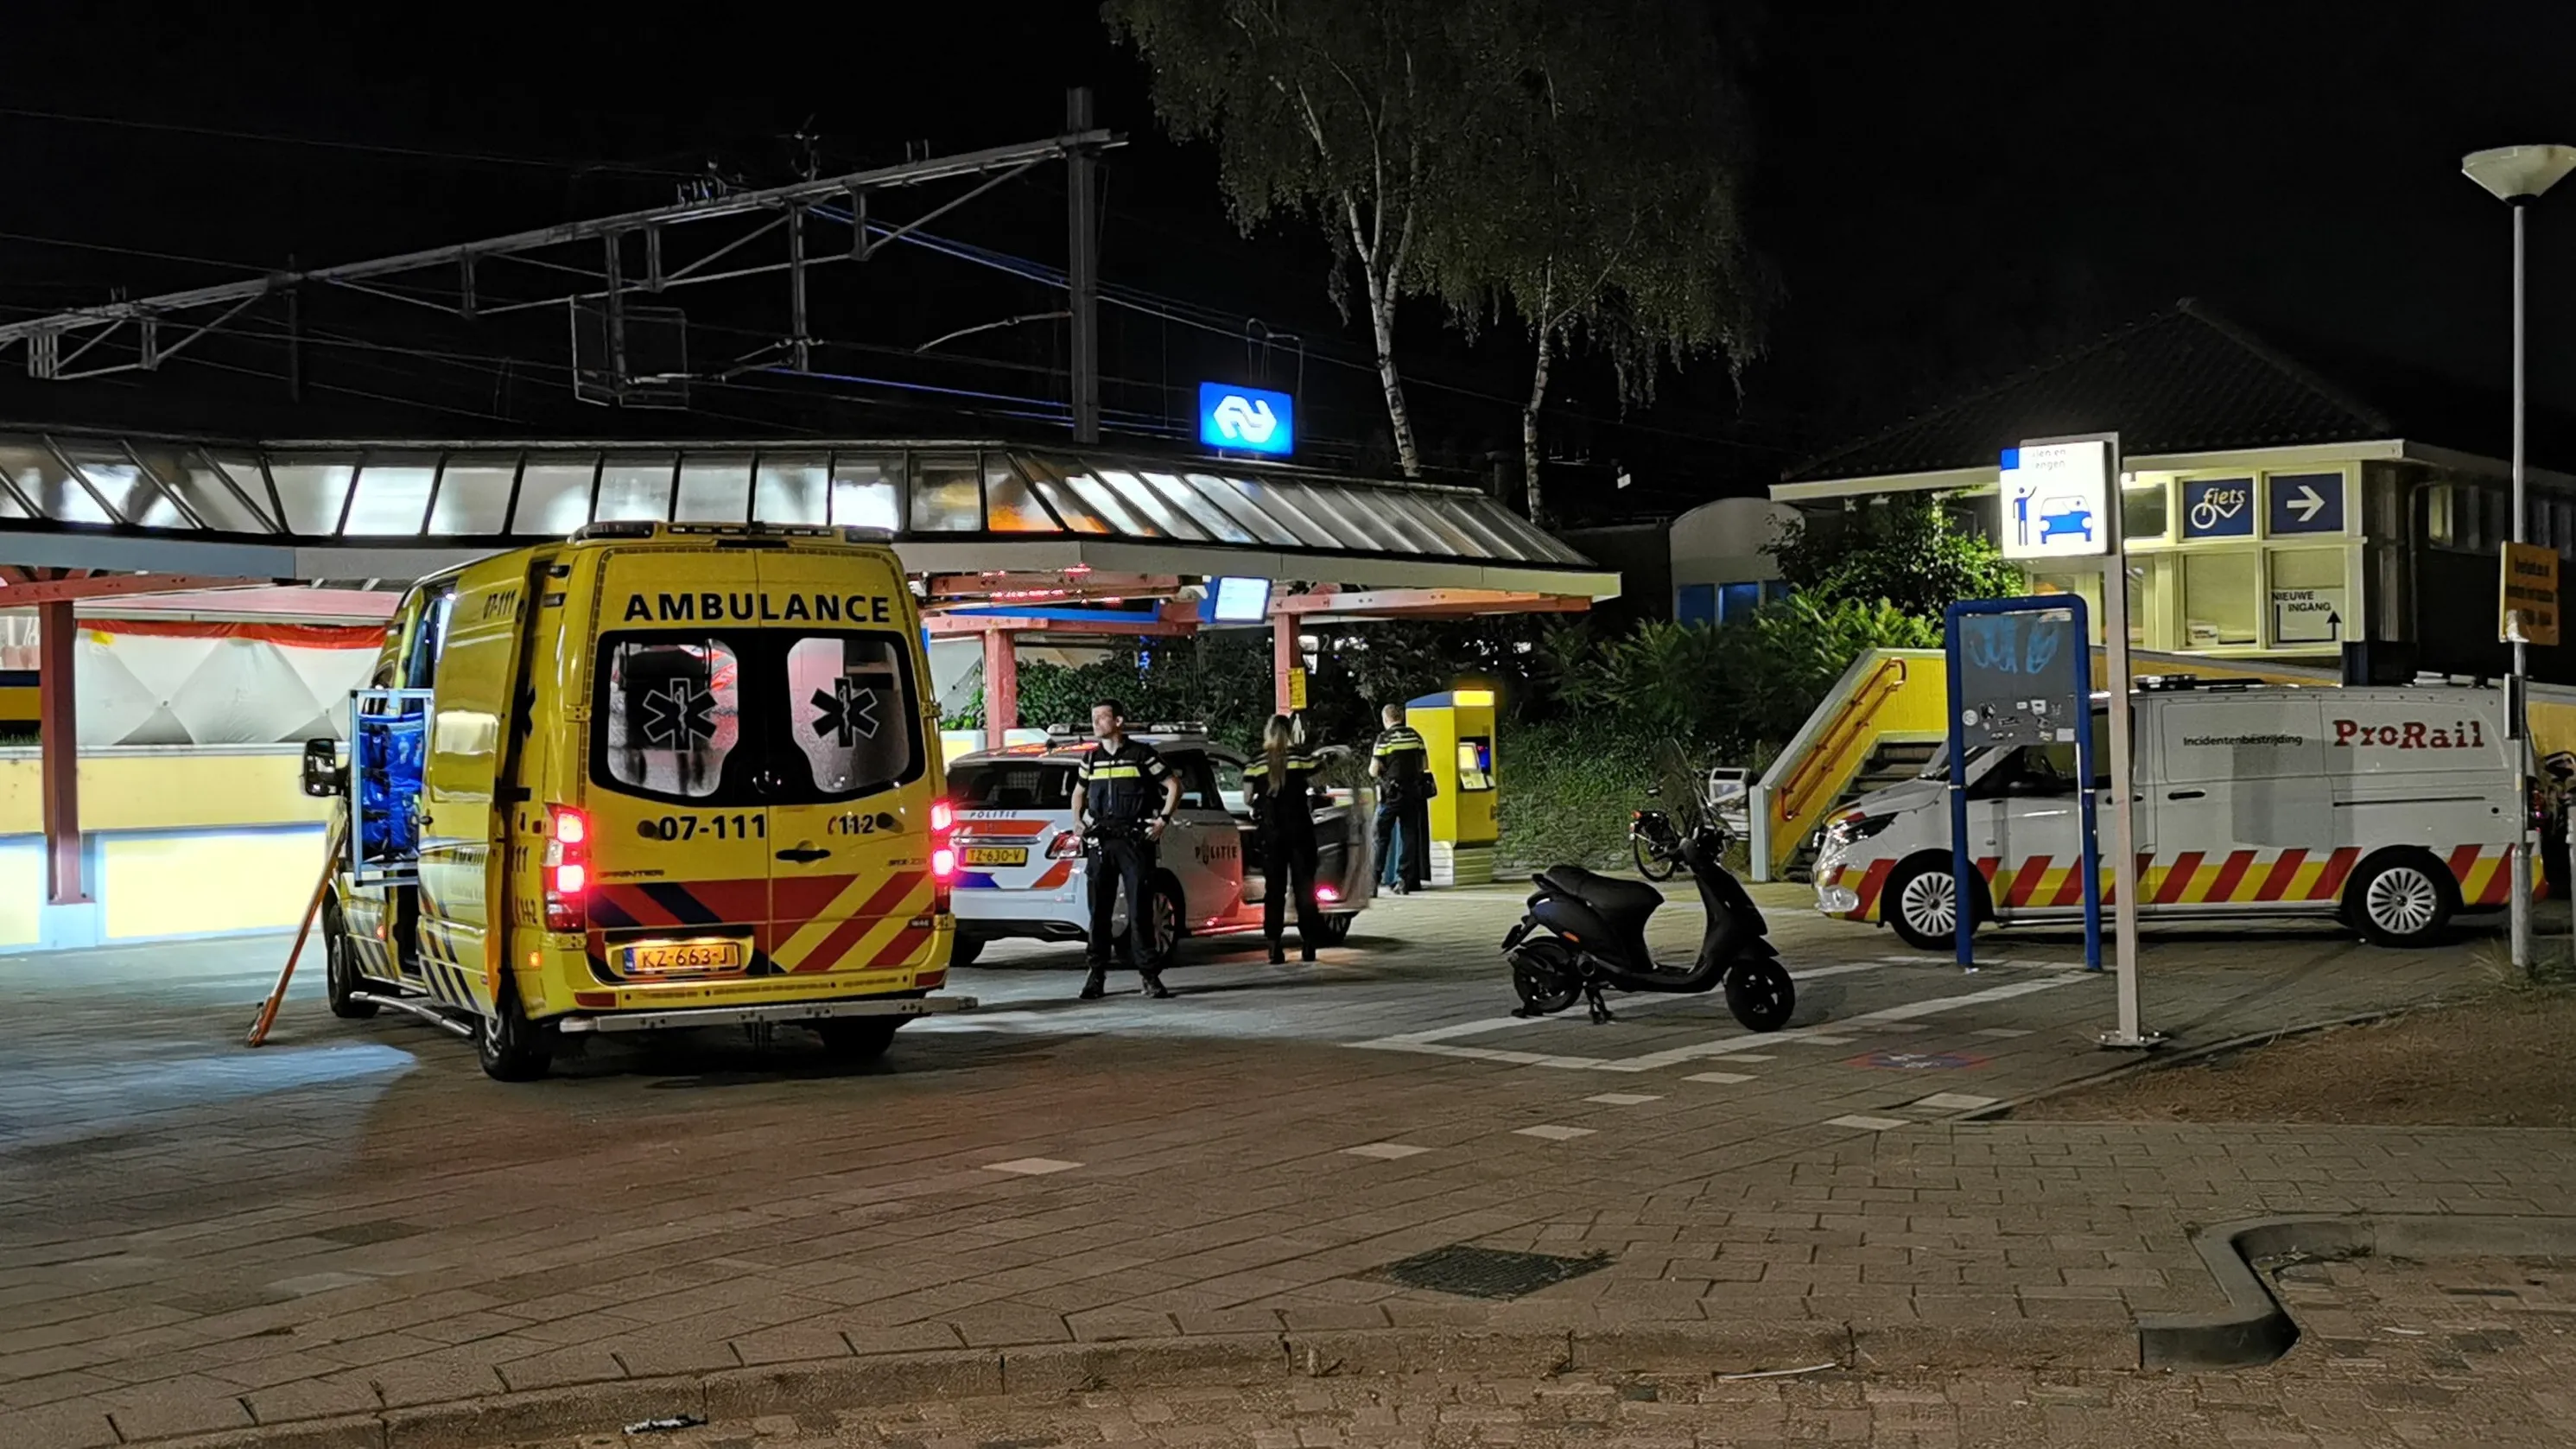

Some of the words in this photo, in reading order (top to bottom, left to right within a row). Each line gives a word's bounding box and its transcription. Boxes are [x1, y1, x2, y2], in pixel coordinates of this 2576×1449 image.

[2203, 487, 2246, 510] fiets
[2271, 591, 2315, 601] NIEUWE
[624, 593, 891, 623] AMBULANCE
[2287, 602, 2332, 613] INGANG
[2183, 734, 2303, 747] Incidentenbestrijding
[2332, 719, 2485, 749] ProRail
[658, 814, 766, 842] 07-111
[969, 848, 1022, 862] TZ-630-V
[642, 947, 728, 968] KZ-663-J
